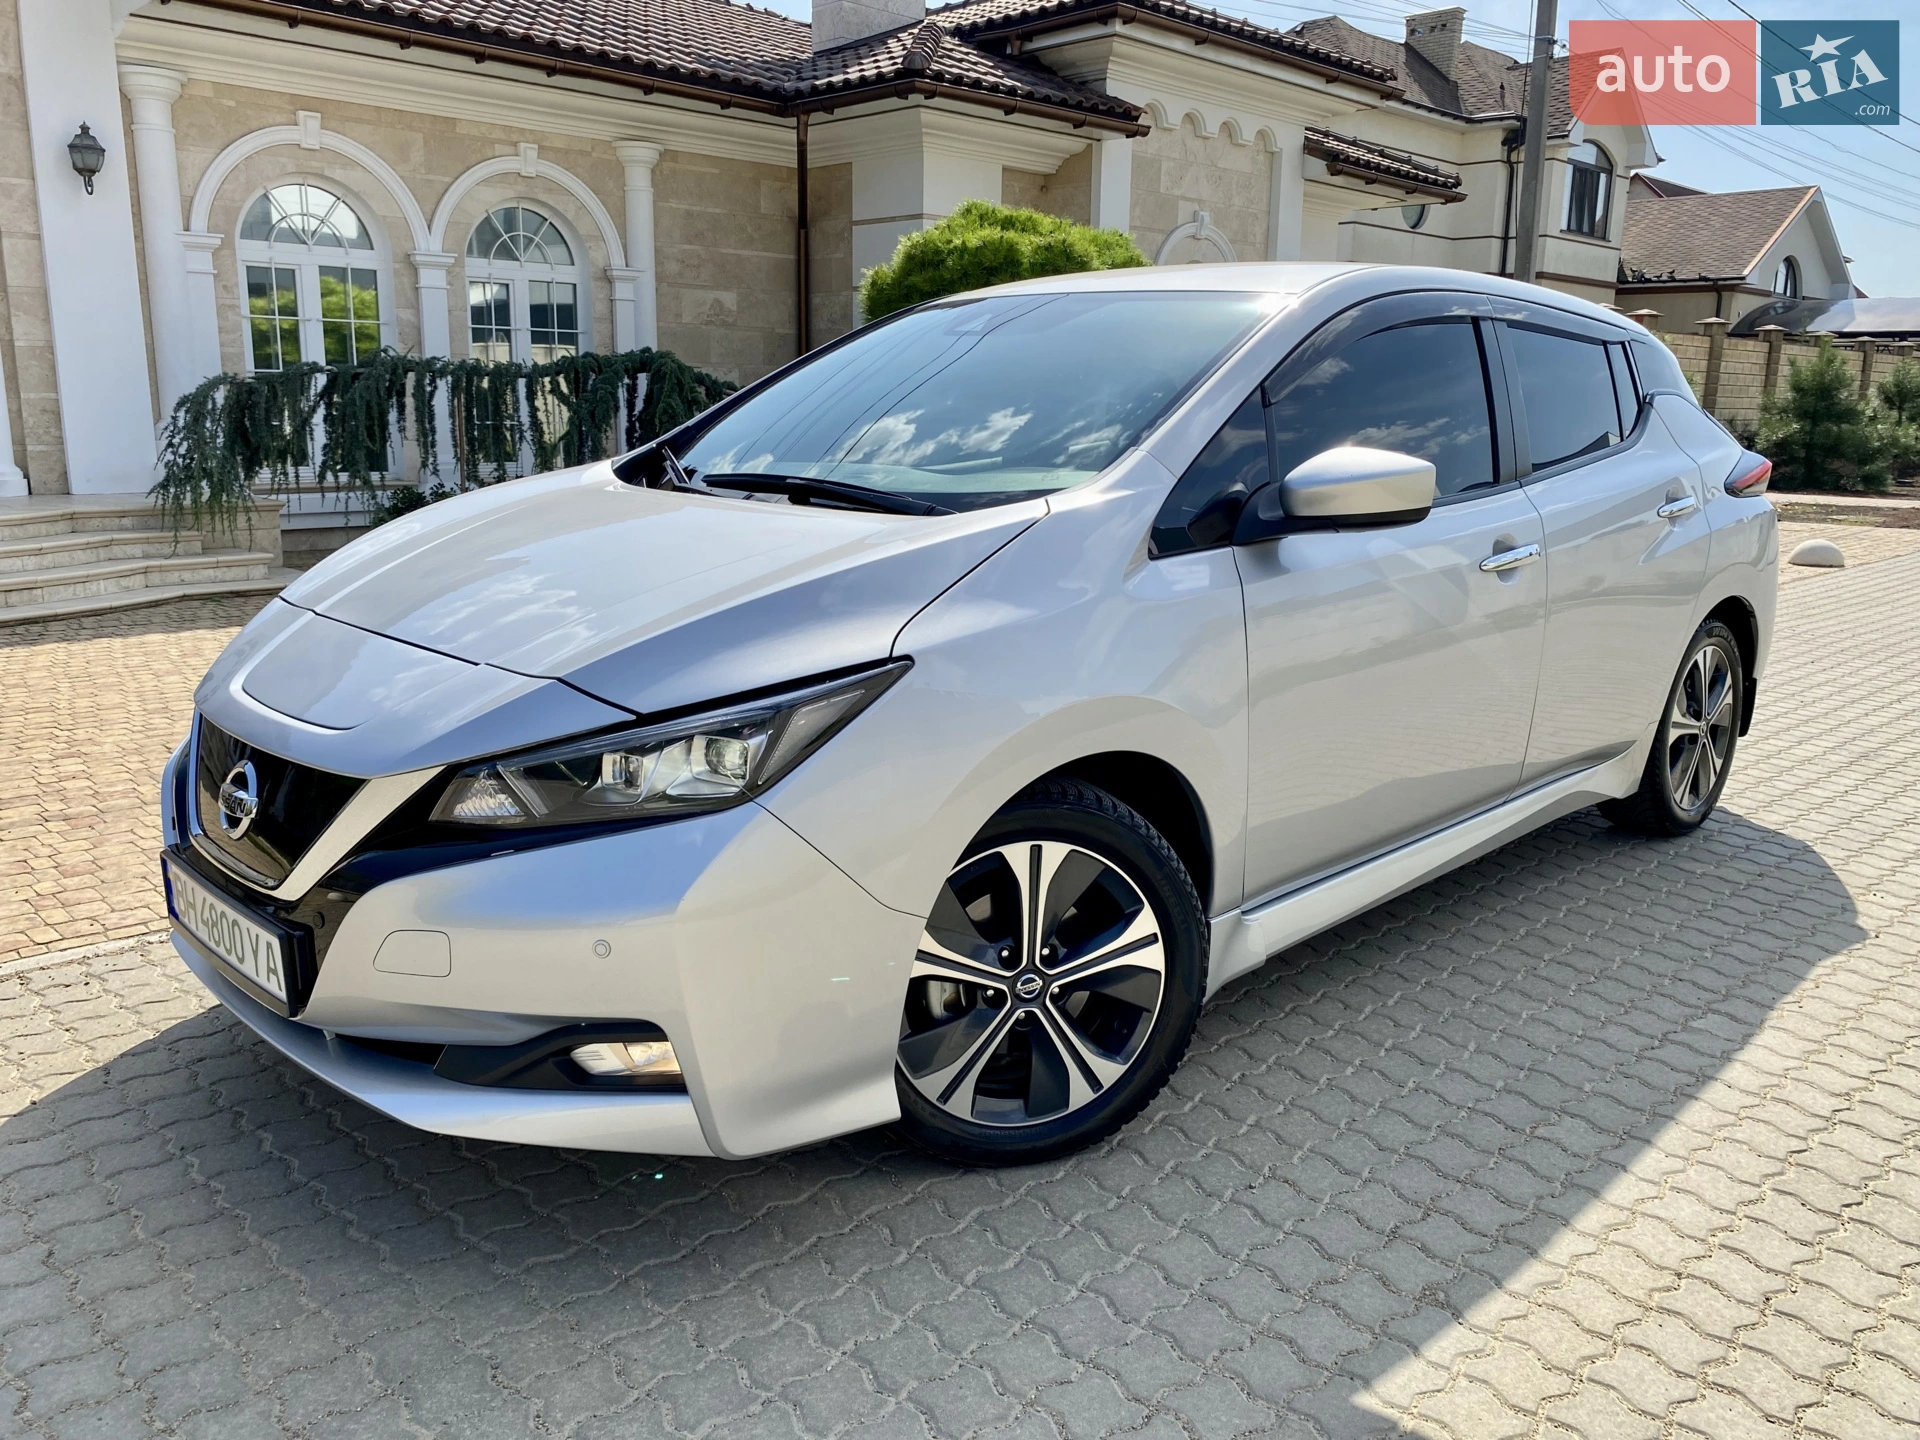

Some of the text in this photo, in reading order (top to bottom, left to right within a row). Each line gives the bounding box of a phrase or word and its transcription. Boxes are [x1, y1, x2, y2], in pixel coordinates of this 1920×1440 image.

[173, 871, 283, 992] BH 4800 YA
